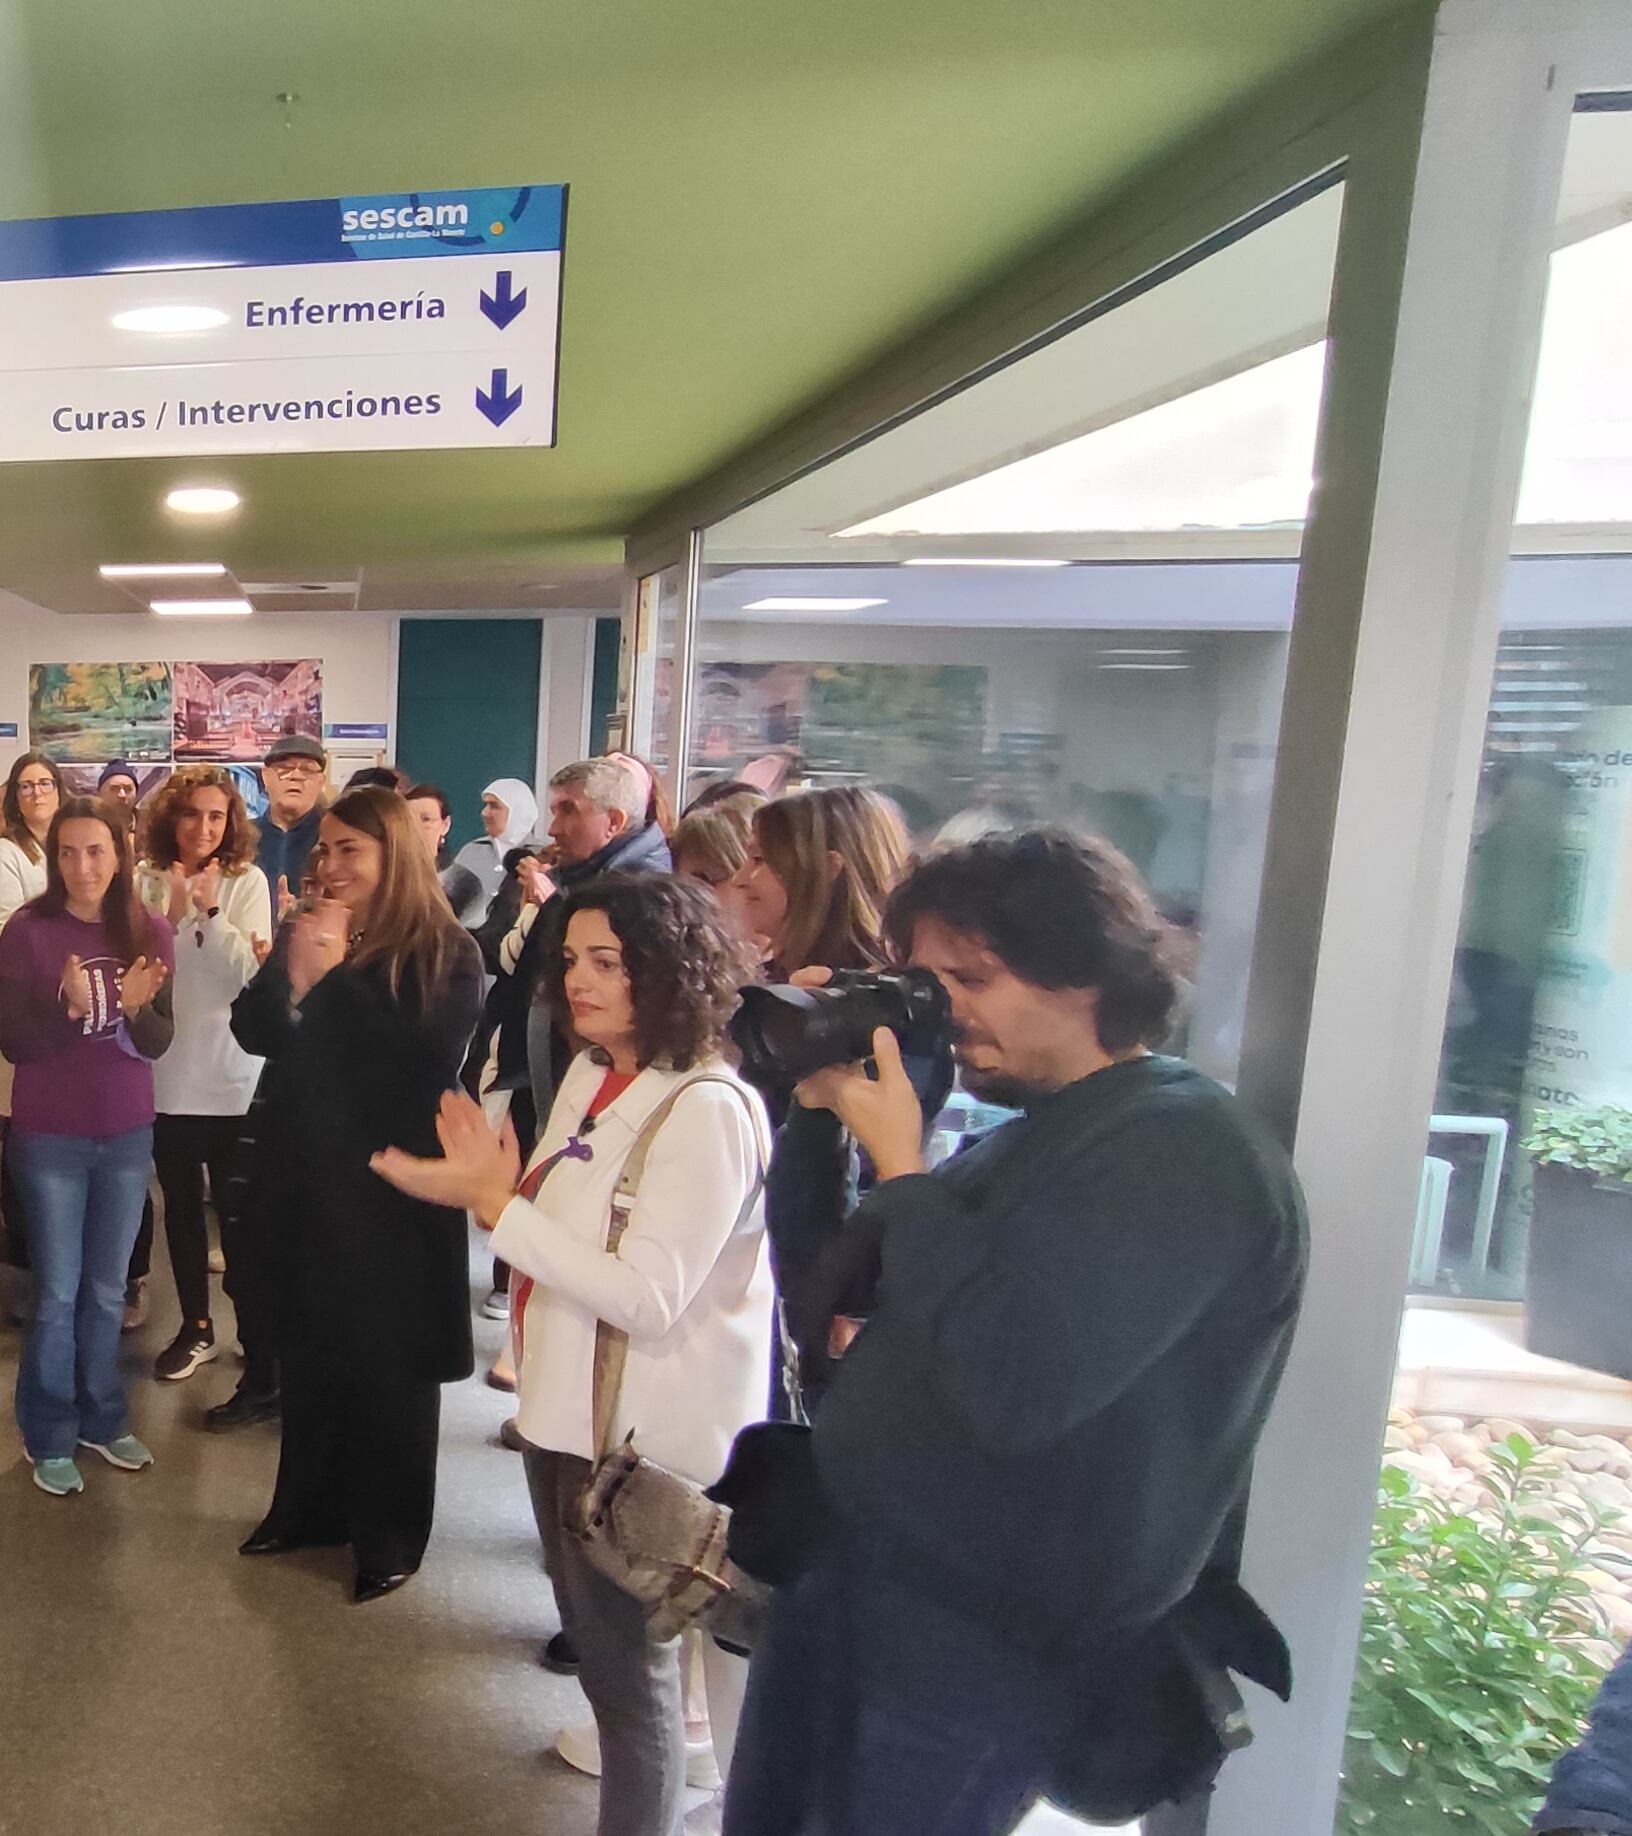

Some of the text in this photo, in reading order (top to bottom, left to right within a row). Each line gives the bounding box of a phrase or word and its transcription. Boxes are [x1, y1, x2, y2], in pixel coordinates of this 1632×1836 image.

[343, 203, 468, 231] sescam
[246, 290, 446, 328] Enfermería
[52, 390, 442, 433] Curas / Intervenciones
